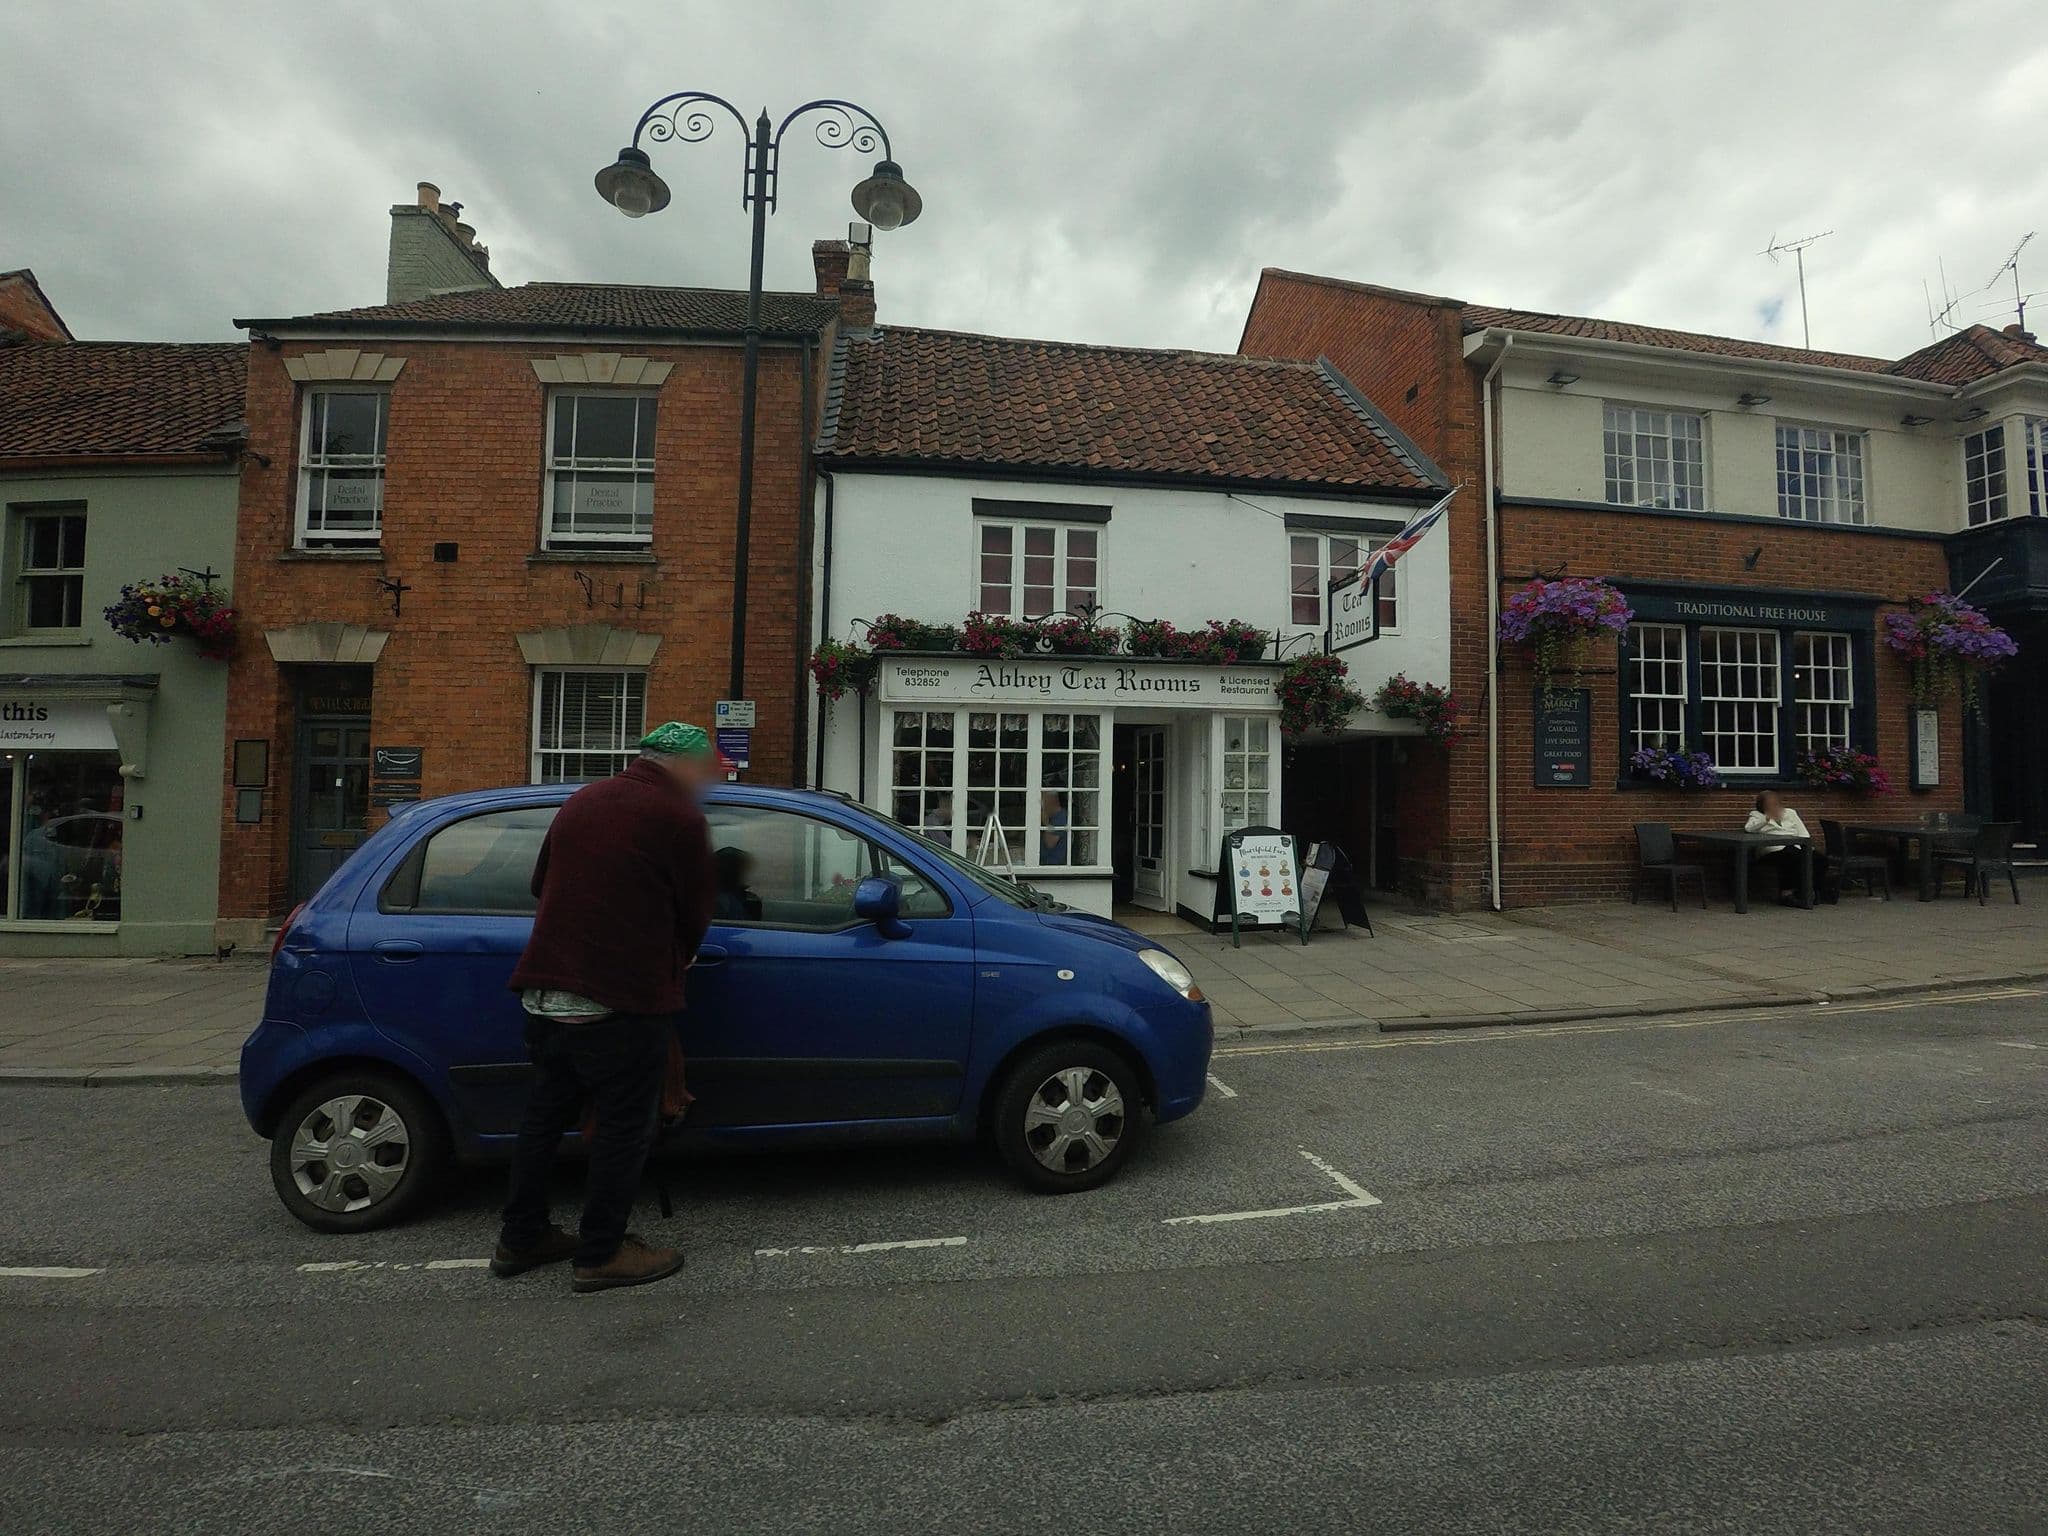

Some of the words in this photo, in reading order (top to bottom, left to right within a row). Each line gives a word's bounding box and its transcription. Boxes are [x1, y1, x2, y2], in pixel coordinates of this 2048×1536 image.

[337, 485, 365, 494] Dental
[590, 488, 619, 497] Dental
[333, 494, 368, 505] Practice
[586, 498, 623, 507] Practice
[1342, 592, 1362, 612] Tea
[1675, 602, 1756, 618] TRADITIONAL
[1760, 607, 1785, 619] FREE
[1788, 608, 1826, 621] HOUSE
[1334, 616, 1371, 642] Rooms
[896, 667, 950, 677] Telephone
[904, 678, 941, 687] 832852
[970, 665, 1052, 695] Abbey
[1060, 666, 1107, 690] Tea
[1114, 668, 1201, 698] Rooms
[1219, 676, 1226, 684] &
[1228, 676, 1270, 686] Licensed
[1221, 685, 1269, 695] Restaurant
[1544, 698, 1579, 711] MARKET
[3, 702, 48, 721] this
[0, 728, 55, 744] lastonbury
